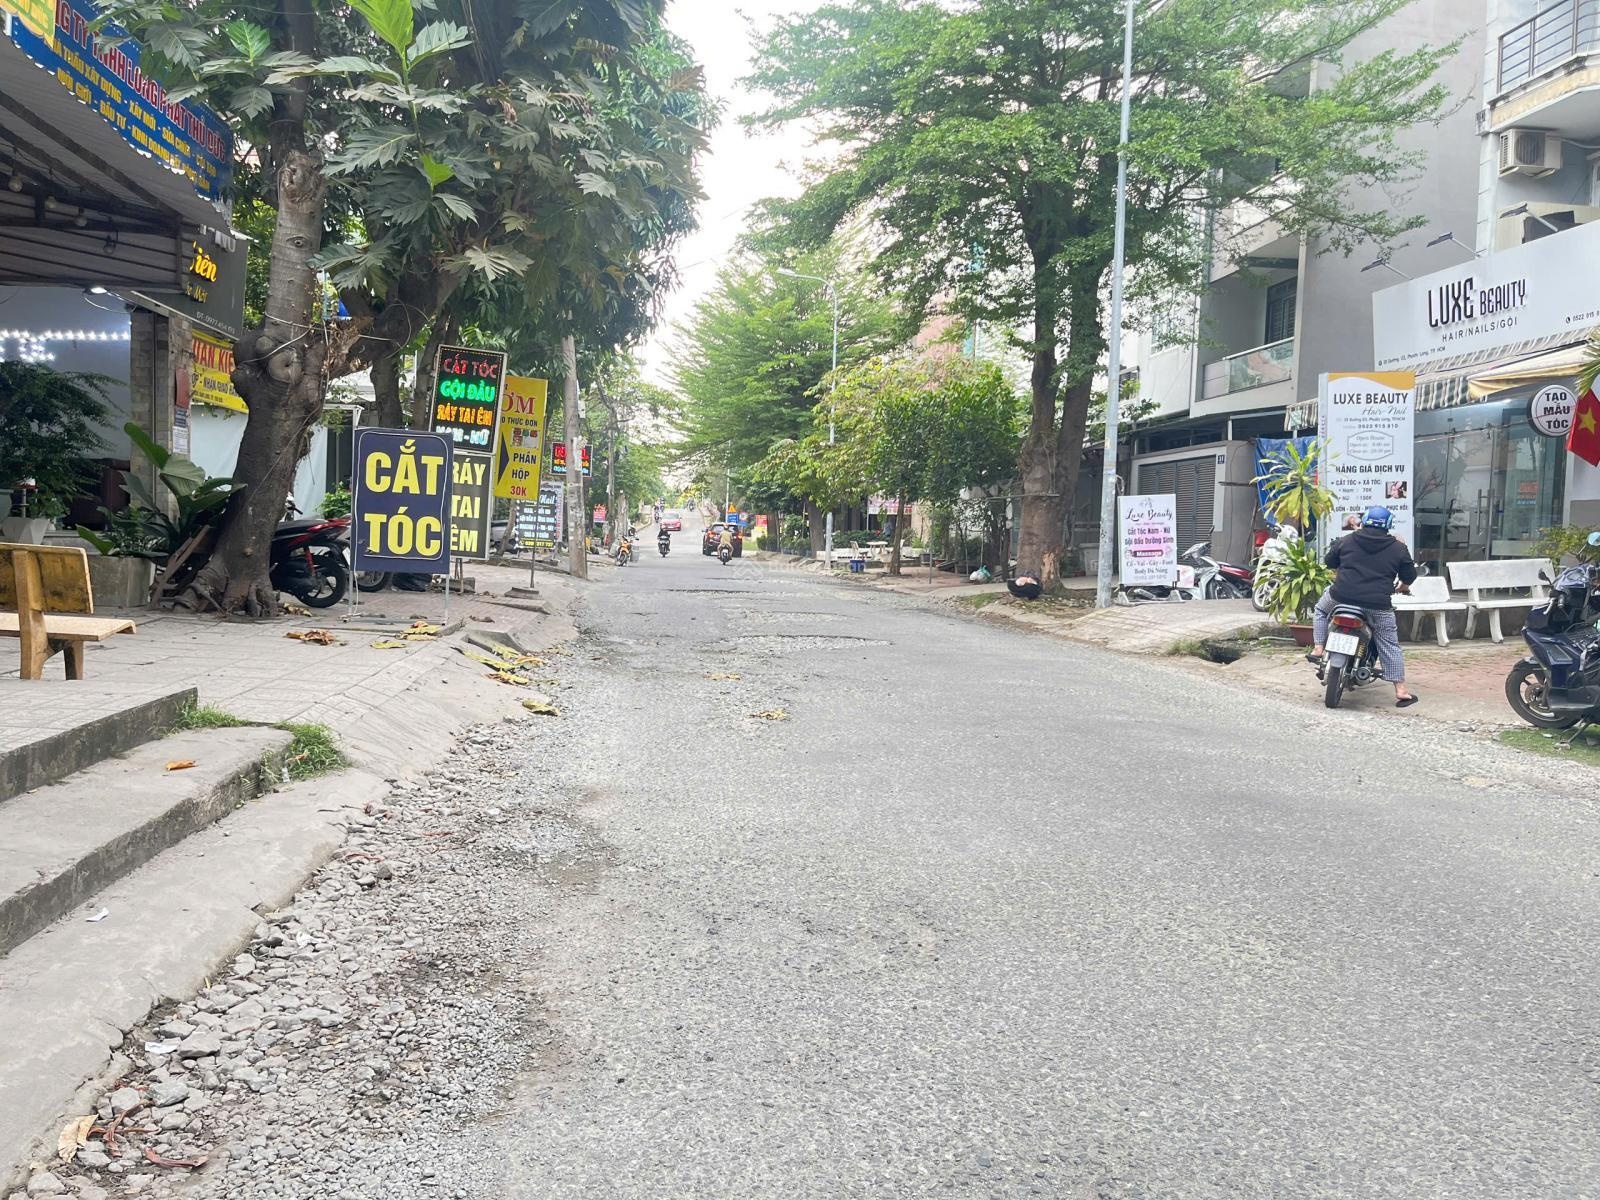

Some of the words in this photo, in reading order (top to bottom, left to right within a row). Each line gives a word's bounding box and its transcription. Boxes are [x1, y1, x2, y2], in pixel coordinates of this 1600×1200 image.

[1428, 277, 1474, 328] LUXE
[1479, 278, 1526, 315] BEAUTY
[444, 354, 468, 375] CẮT
[472, 360, 498, 379] TÓC
[440, 378, 465, 400] GỘI
[467, 379, 496, 403] ĐẦU
[1333, 393, 1362, 405] LUXE
[1365, 392, 1409, 405] BEAUTY
[1545, 392, 1567, 403] TẠO
[437, 403, 457, 423] RÁY
[458, 406, 476, 424] TAI
[1543, 402, 1571, 415] MẪU
[1546, 418, 1569, 429] TÓC
[365, 439, 444, 496] CẮT
[452, 458, 486, 486] RÁY
[511, 468, 530, 482] HỘP
[1359, 463, 1373, 473] GIÁ
[1374, 464, 1393, 475] DỊCH
[1394, 464, 1405, 475] VỤ
[510, 485, 527, 496] 30K
[451, 495, 480, 519] TAI
[1125, 508, 1144, 522] Luxe
[1147, 508, 1173, 521] Beauty
[364, 506, 442, 557] TÓC
